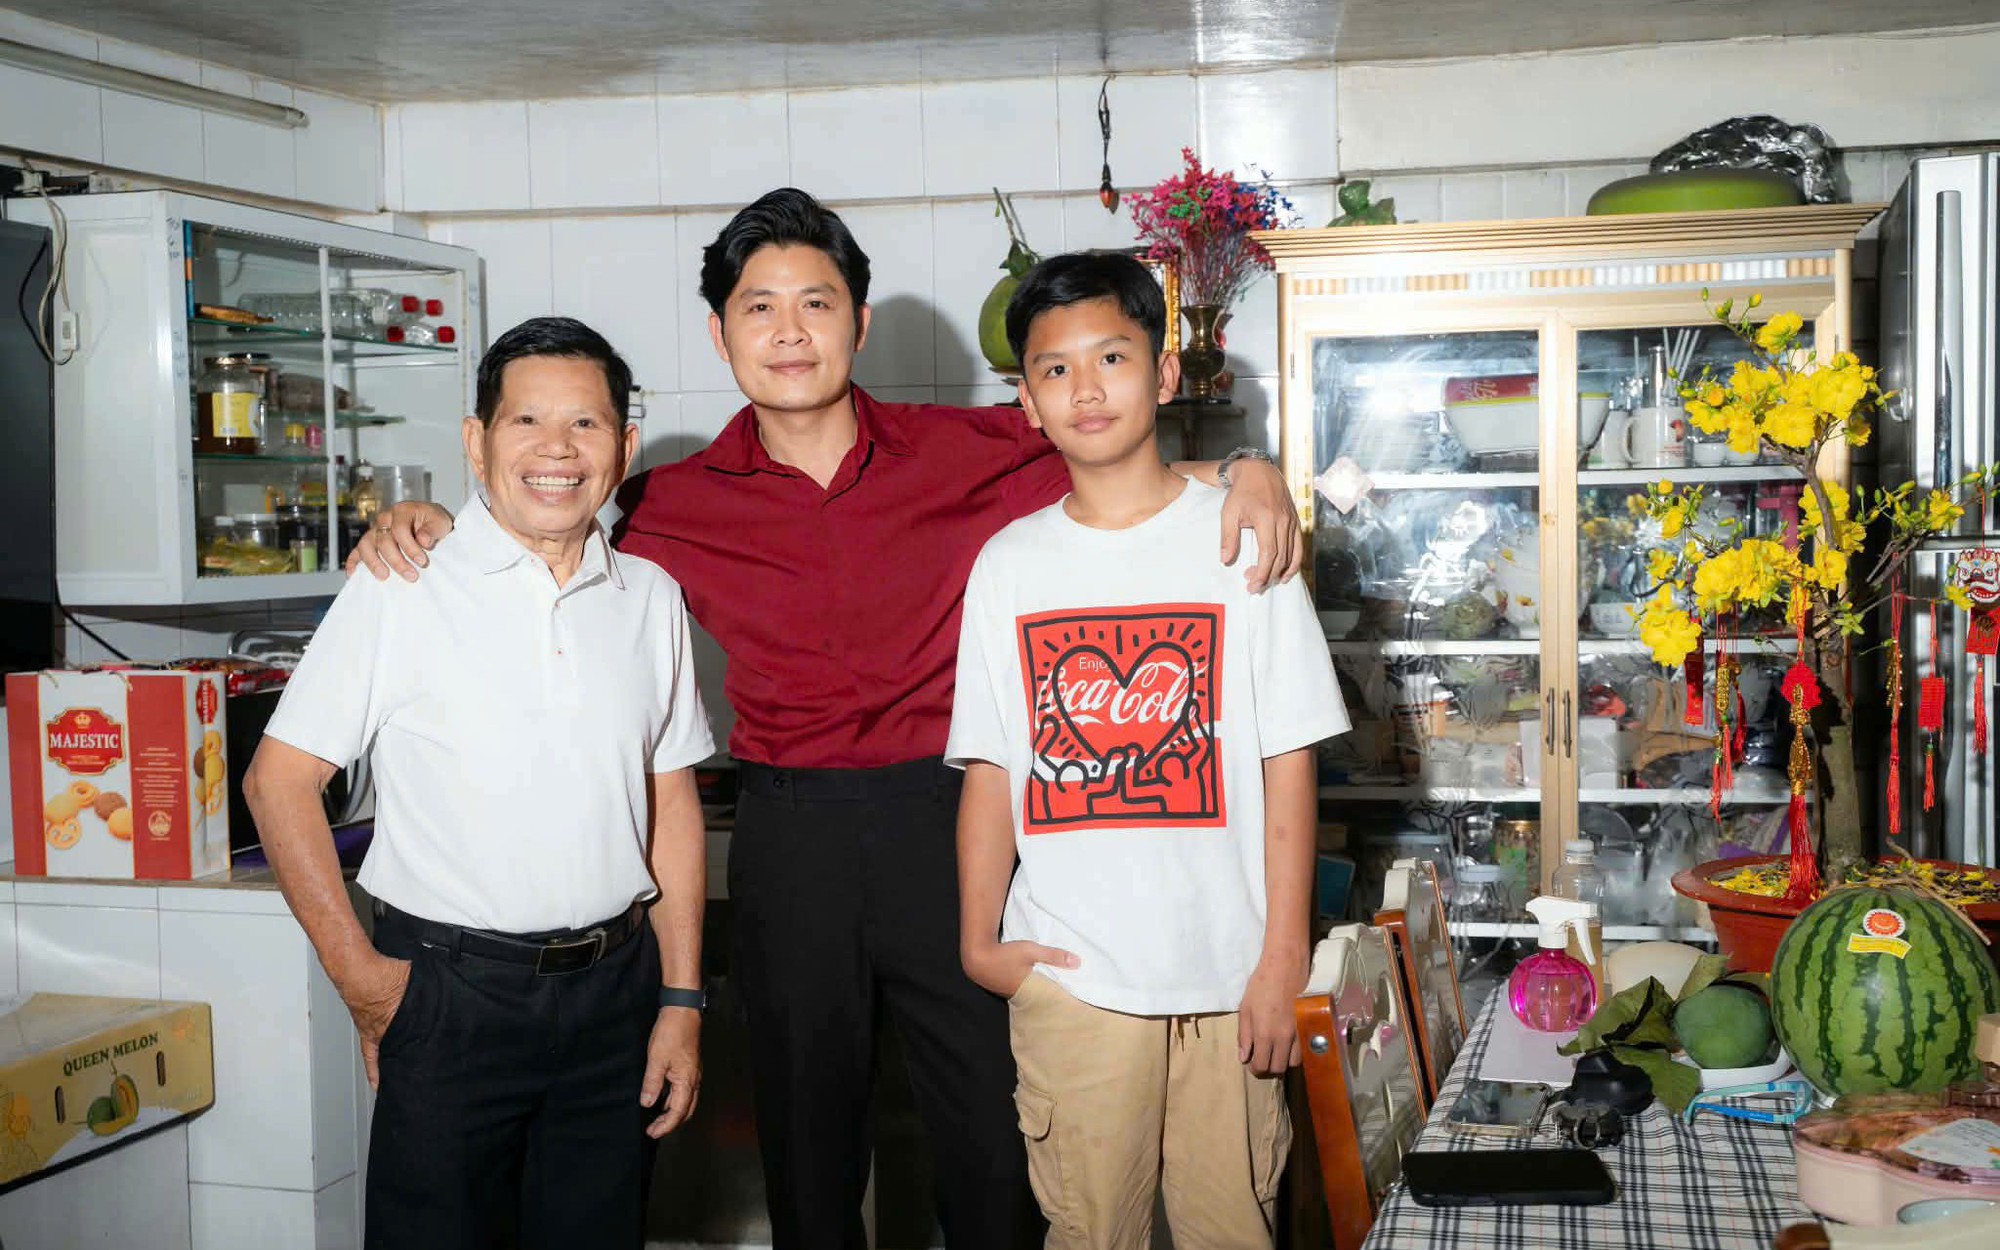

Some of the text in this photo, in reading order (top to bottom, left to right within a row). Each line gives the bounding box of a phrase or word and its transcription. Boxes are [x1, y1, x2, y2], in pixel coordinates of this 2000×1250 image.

[1079, 656, 1115, 672] Enjo
[50, 732, 119, 749] MAJESTIC
[63, 1032, 158, 1077] QUEEN MELON
